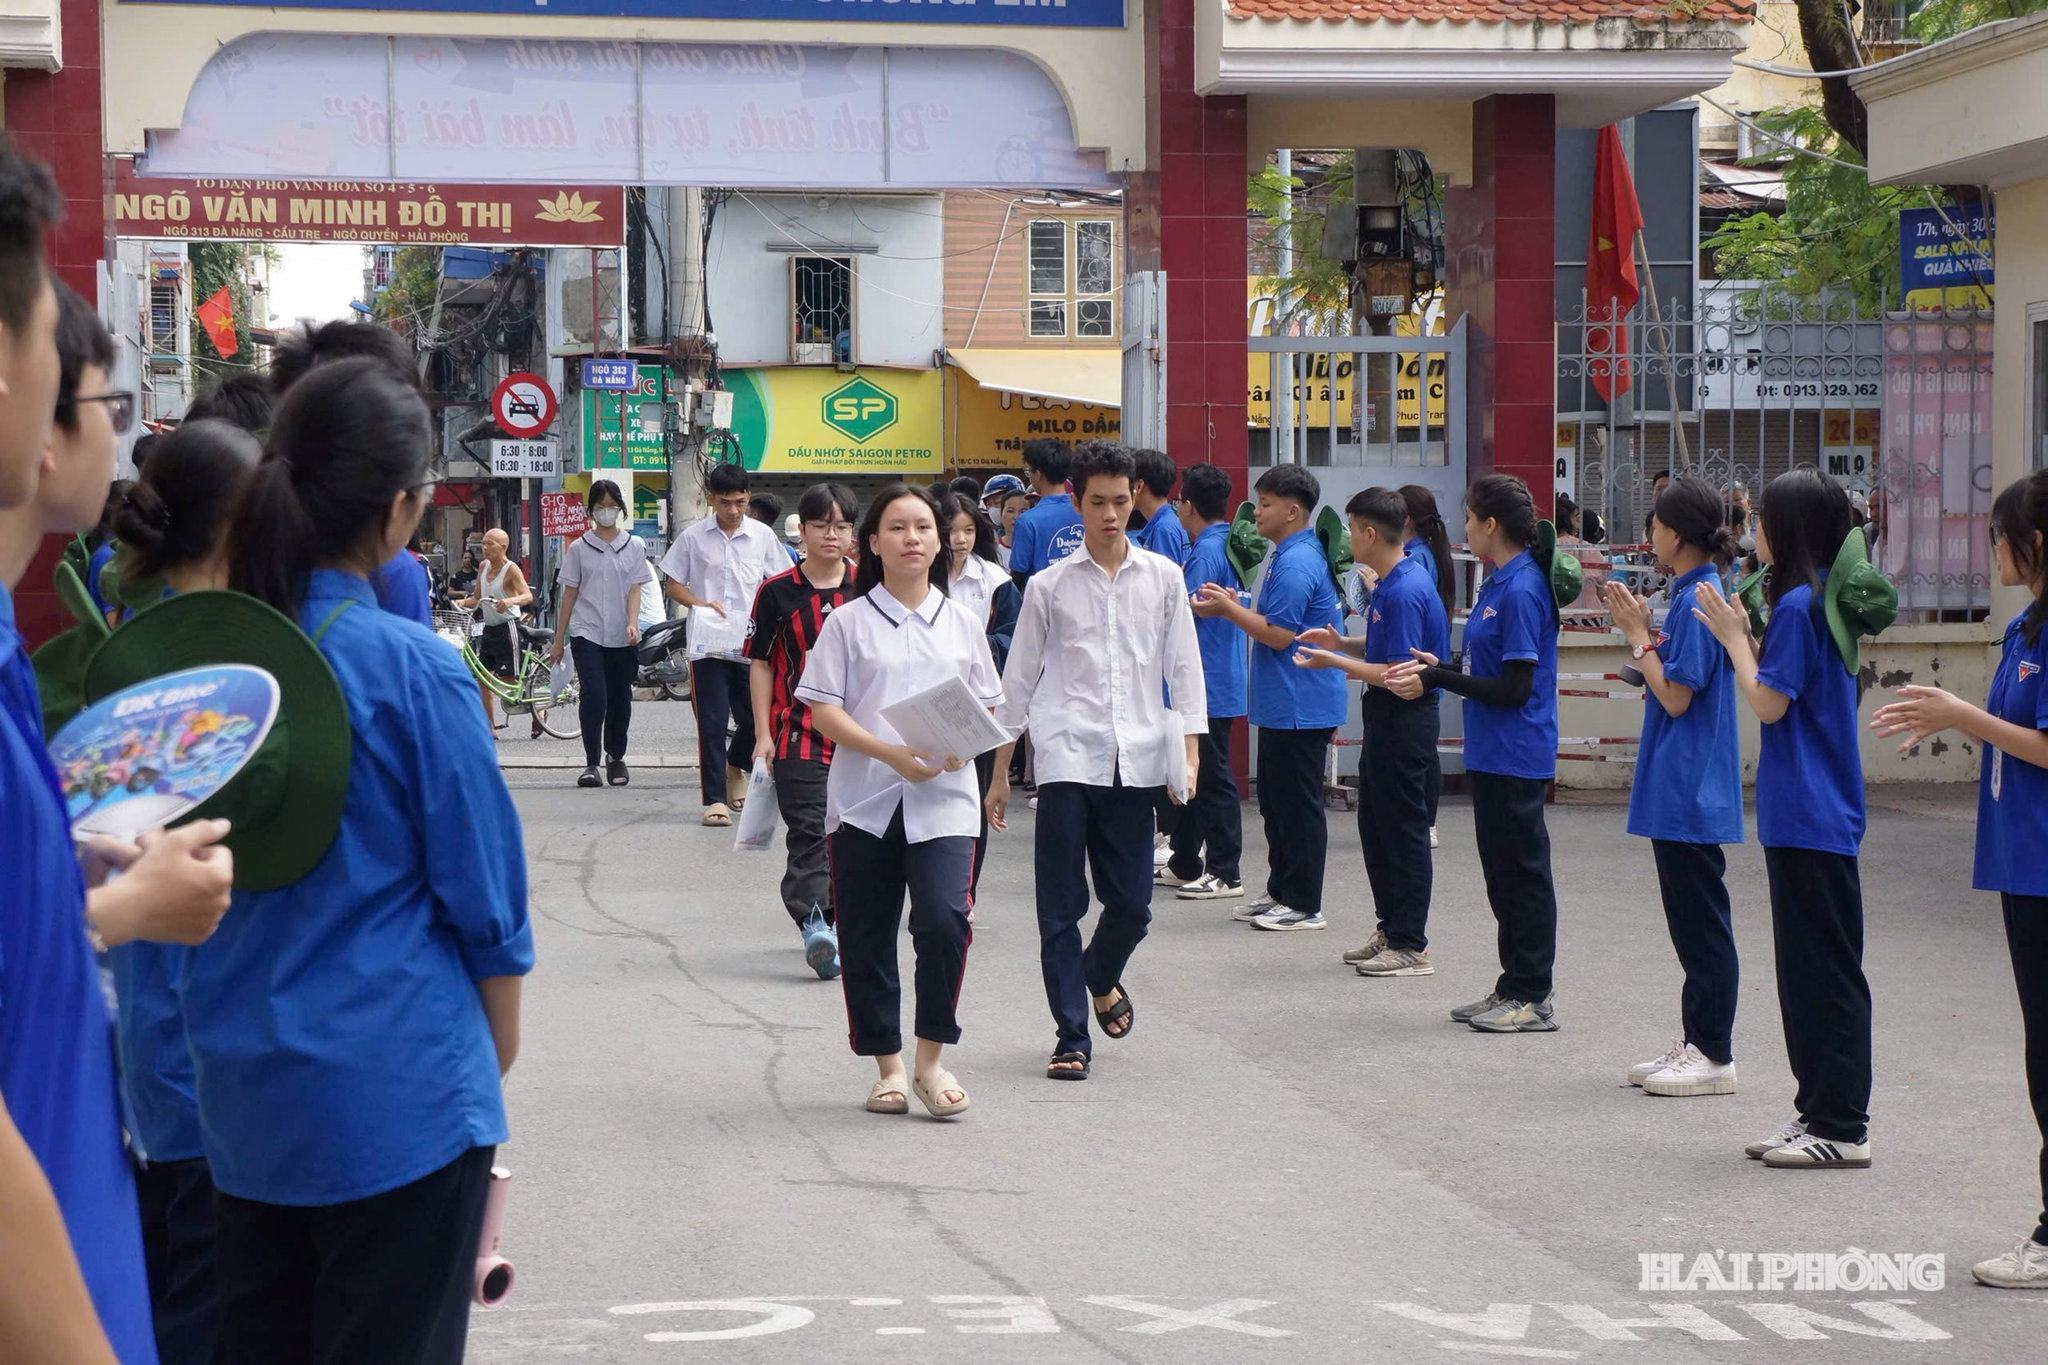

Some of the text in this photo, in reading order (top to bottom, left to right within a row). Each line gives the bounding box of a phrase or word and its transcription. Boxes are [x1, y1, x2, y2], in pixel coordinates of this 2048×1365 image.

[388, 183, 397, 194] 4
[408, 183, 416, 194] 5
[427, 184, 436, 194] 6
[115, 189, 512, 233] NGÕ VĂN MINH ĐÔ THỊ
[190, 226, 209, 237] 313
[212, 223, 229, 237] ĐÀ
[299, 229, 321, 240] TRE
[408, 228, 427, 242] HẢI
[430, 231, 469, 243] PHÒNG
[1916, 221, 1939, 237] 17h,
[1913, 243, 1949, 259] SALE
[612, 365, 627, 375] 313
[833, 398, 887, 421] SP
[1027, 419, 1077, 433] MILO
[637, 432, 656, 444] PHỤ
[500, 445, 520, 457] 6:30
[528, 446, 548, 458] 8:00
[814, 447, 846, 458] NHỚT
[849, 448, 894, 458] SAIGON
[895, 449, 932, 459] PETRO
[495, 459, 519, 472] 16:30
[530, 460, 554, 473] 18:00
[632, 455, 647, 465] ĐT:
[1373, 1300, 1953, 1359] NHÀ
